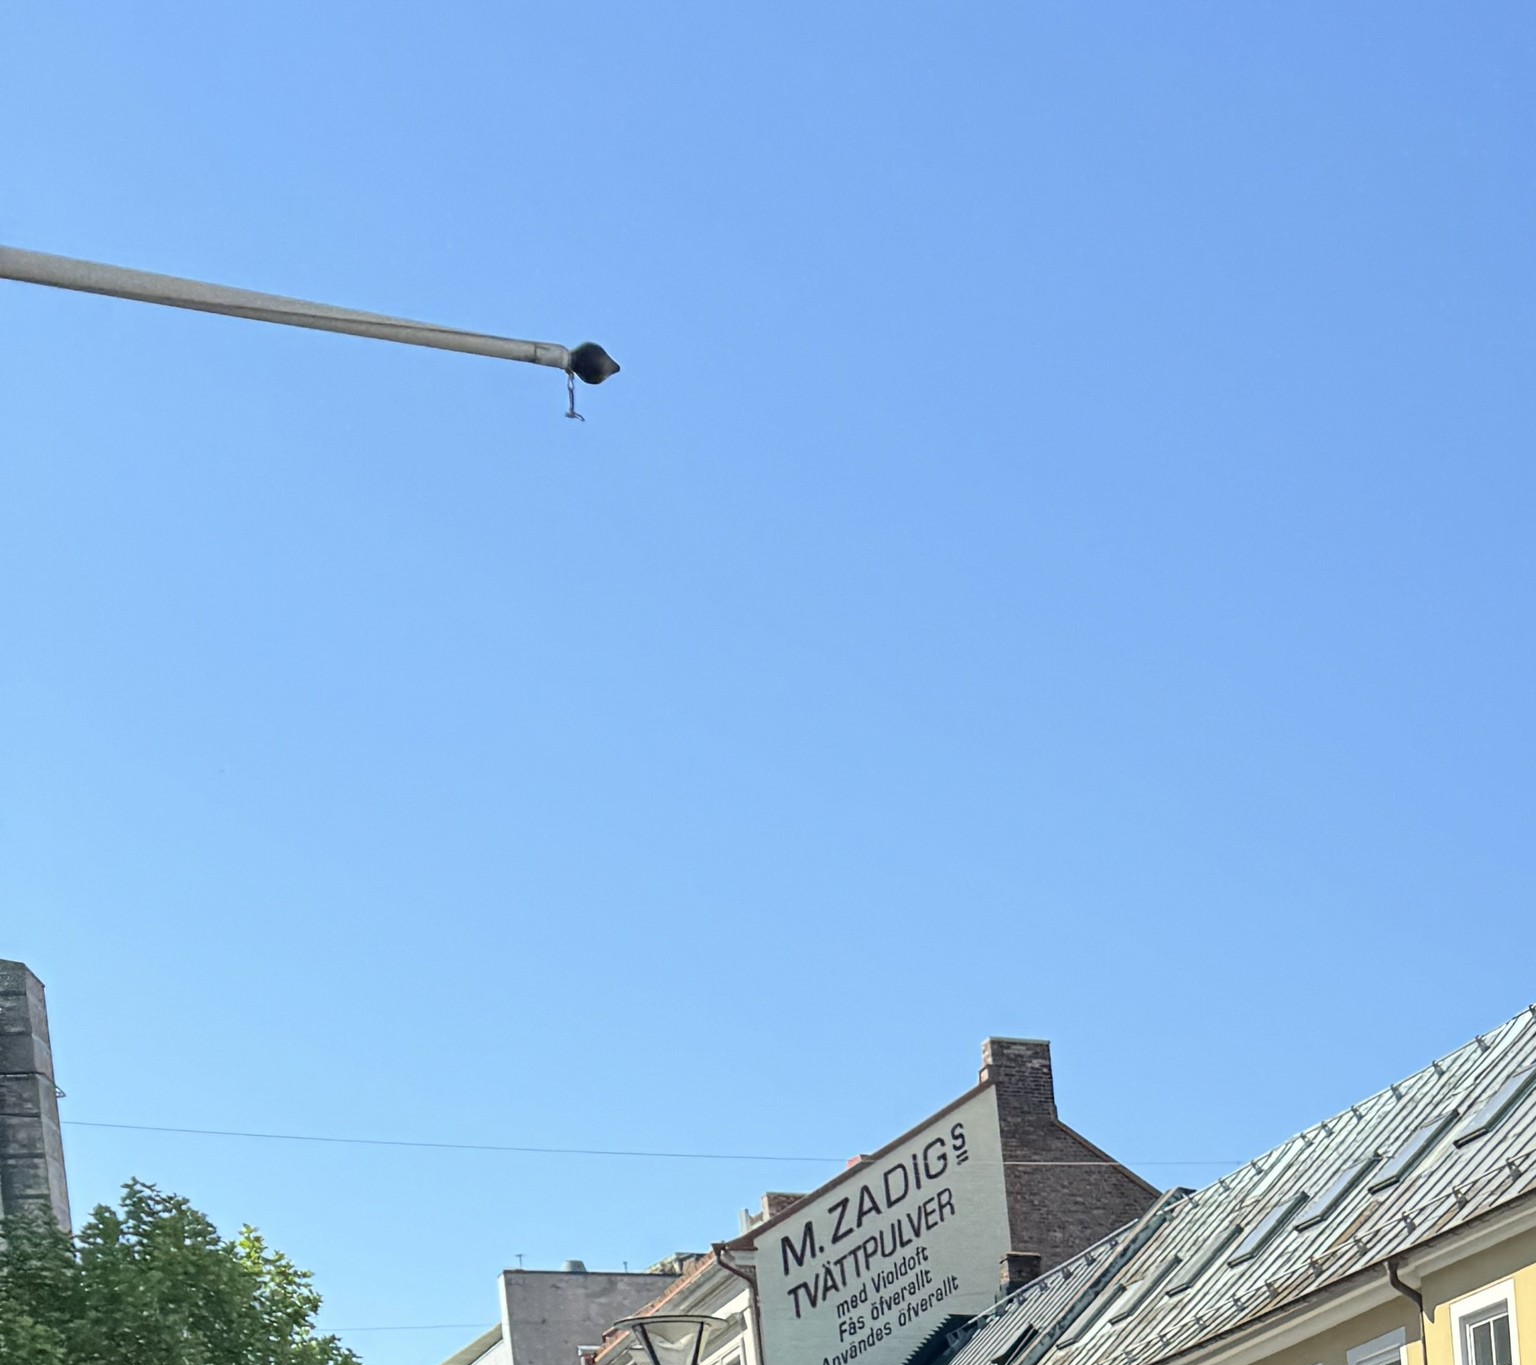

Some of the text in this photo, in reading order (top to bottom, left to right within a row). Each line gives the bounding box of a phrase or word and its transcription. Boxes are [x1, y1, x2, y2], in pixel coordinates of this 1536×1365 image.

[787, 1187, 956, 1319] TVÄTTPULVER
[836, 1246, 929, 1319] med Violdoft
[838, 1269, 933, 1343] Fås öfverallt
[898, 1275, 960, 1327] öfverallt
